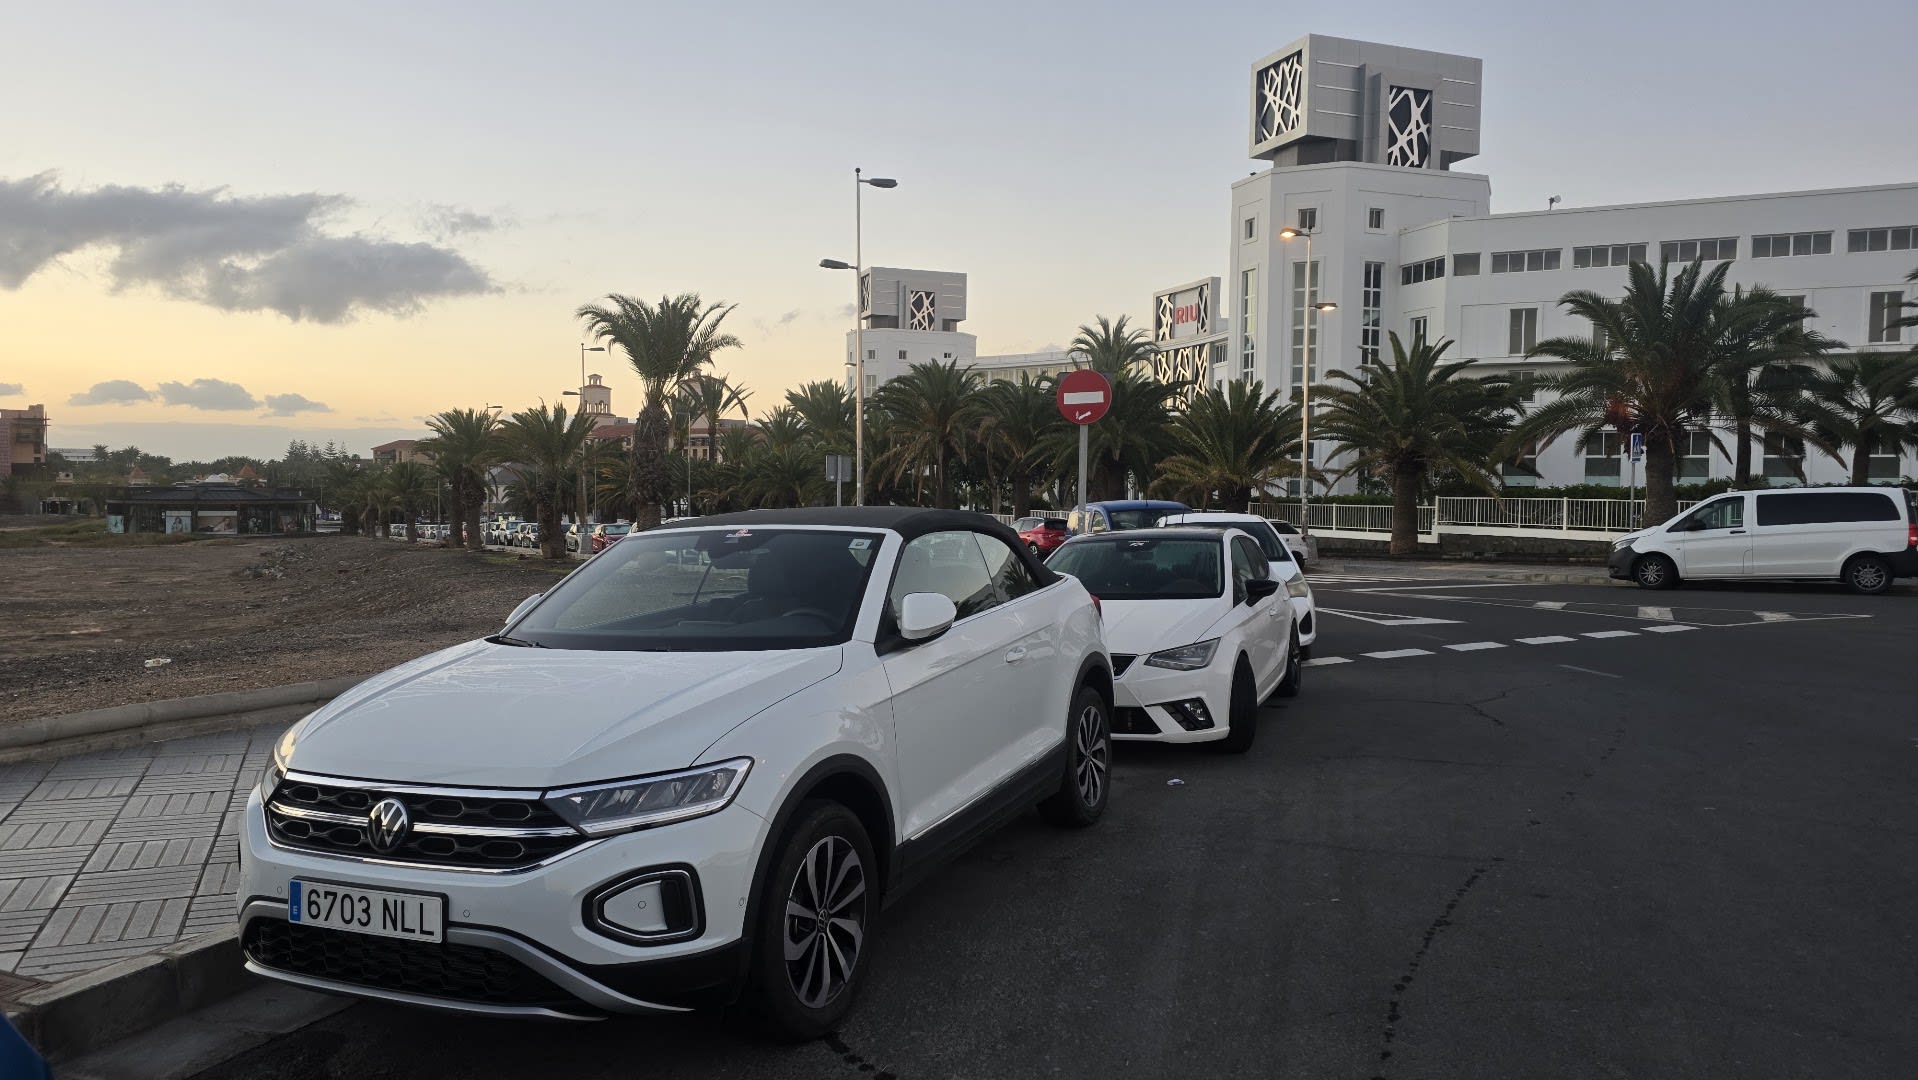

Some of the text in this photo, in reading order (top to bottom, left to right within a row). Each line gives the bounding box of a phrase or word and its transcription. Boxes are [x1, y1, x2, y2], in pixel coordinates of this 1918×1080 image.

[1175, 303, 1199, 325] RIU
[307, 888, 435, 937] 6703 NLL
